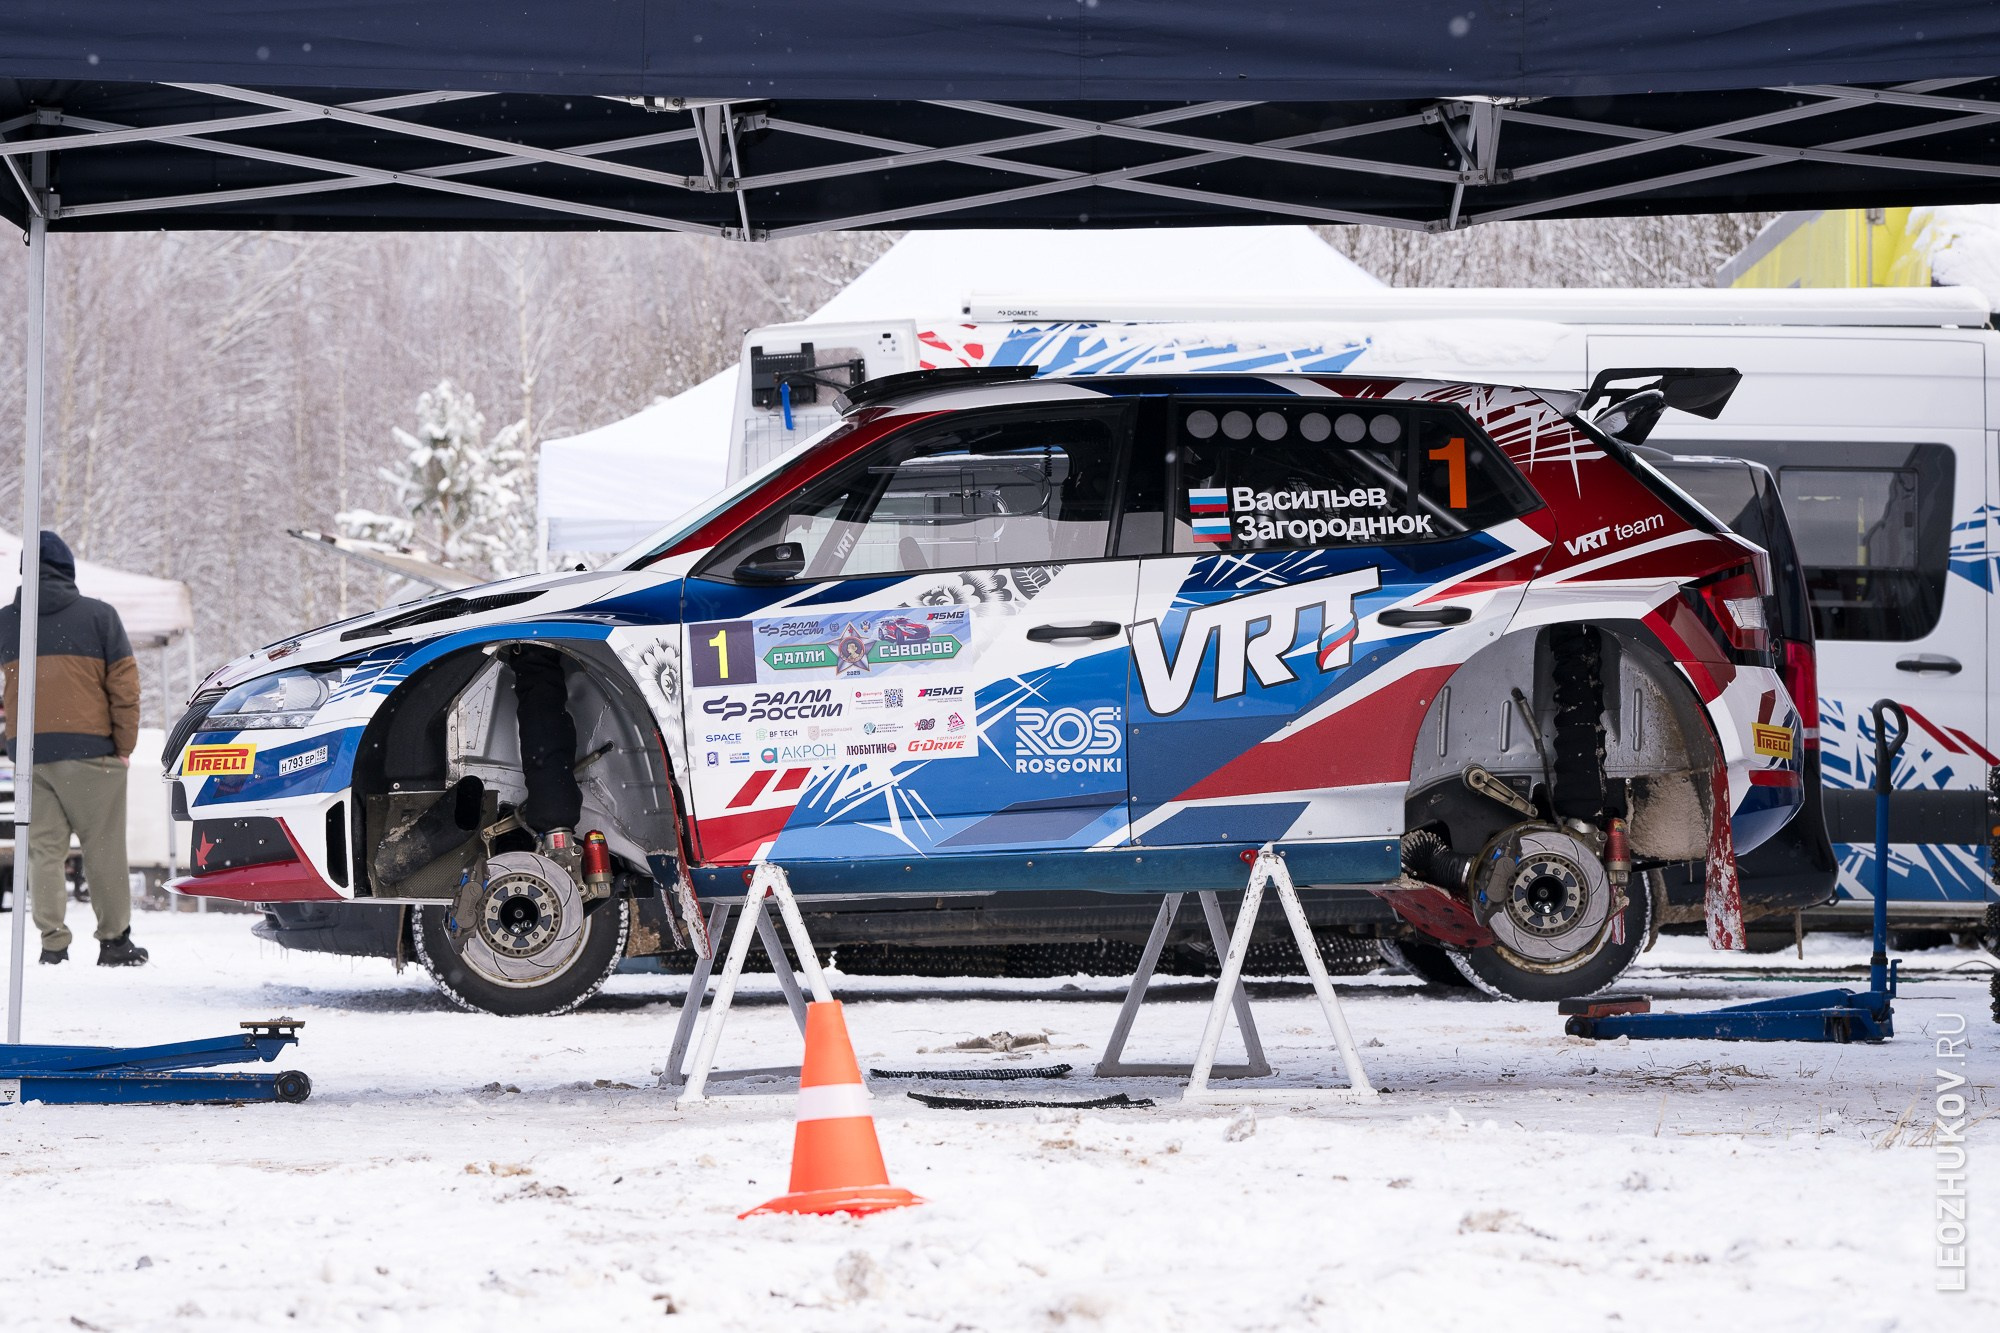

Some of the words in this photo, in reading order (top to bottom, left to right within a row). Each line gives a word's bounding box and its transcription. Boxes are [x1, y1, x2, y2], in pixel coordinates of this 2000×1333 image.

[1428, 437, 1468, 509] 1
[1232, 486, 1388, 512] Васильев
[1236, 513, 1434, 544] Загороднюк
[1563, 526, 1611, 557] VRT
[1613, 513, 1665, 541] team
[833, 528, 856, 560] VRT
[781, 620, 820, 630] РАЛЛИ
[930, 610, 965, 620] ASMG
[779, 626, 825, 637] РОССИИ
[1124, 563, 1383, 718] VRT
[708, 629, 729, 679] 1
[773, 649, 826, 665] РАЛЛИ
[879, 641, 954, 658] СУВОРОВ
[752, 688, 832, 707] РАЛЛИ
[923, 686, 964, 697] ASMG
[747, 702, 843, 723] РОССИИ
[705, 732, 742, 743] SPACE
[769, 730, 778, 738] BF
[780, 729, 798, 737] TECH
[1015, 706, 1122, 756] ROS
[1755, 728, 1791, 753] PIRELLI
[187, 748, 250, 772] PIRELLI
[781, 743, 837, 760] АКРОН
[1015, 757, 1122, 774] ROSGONKI
